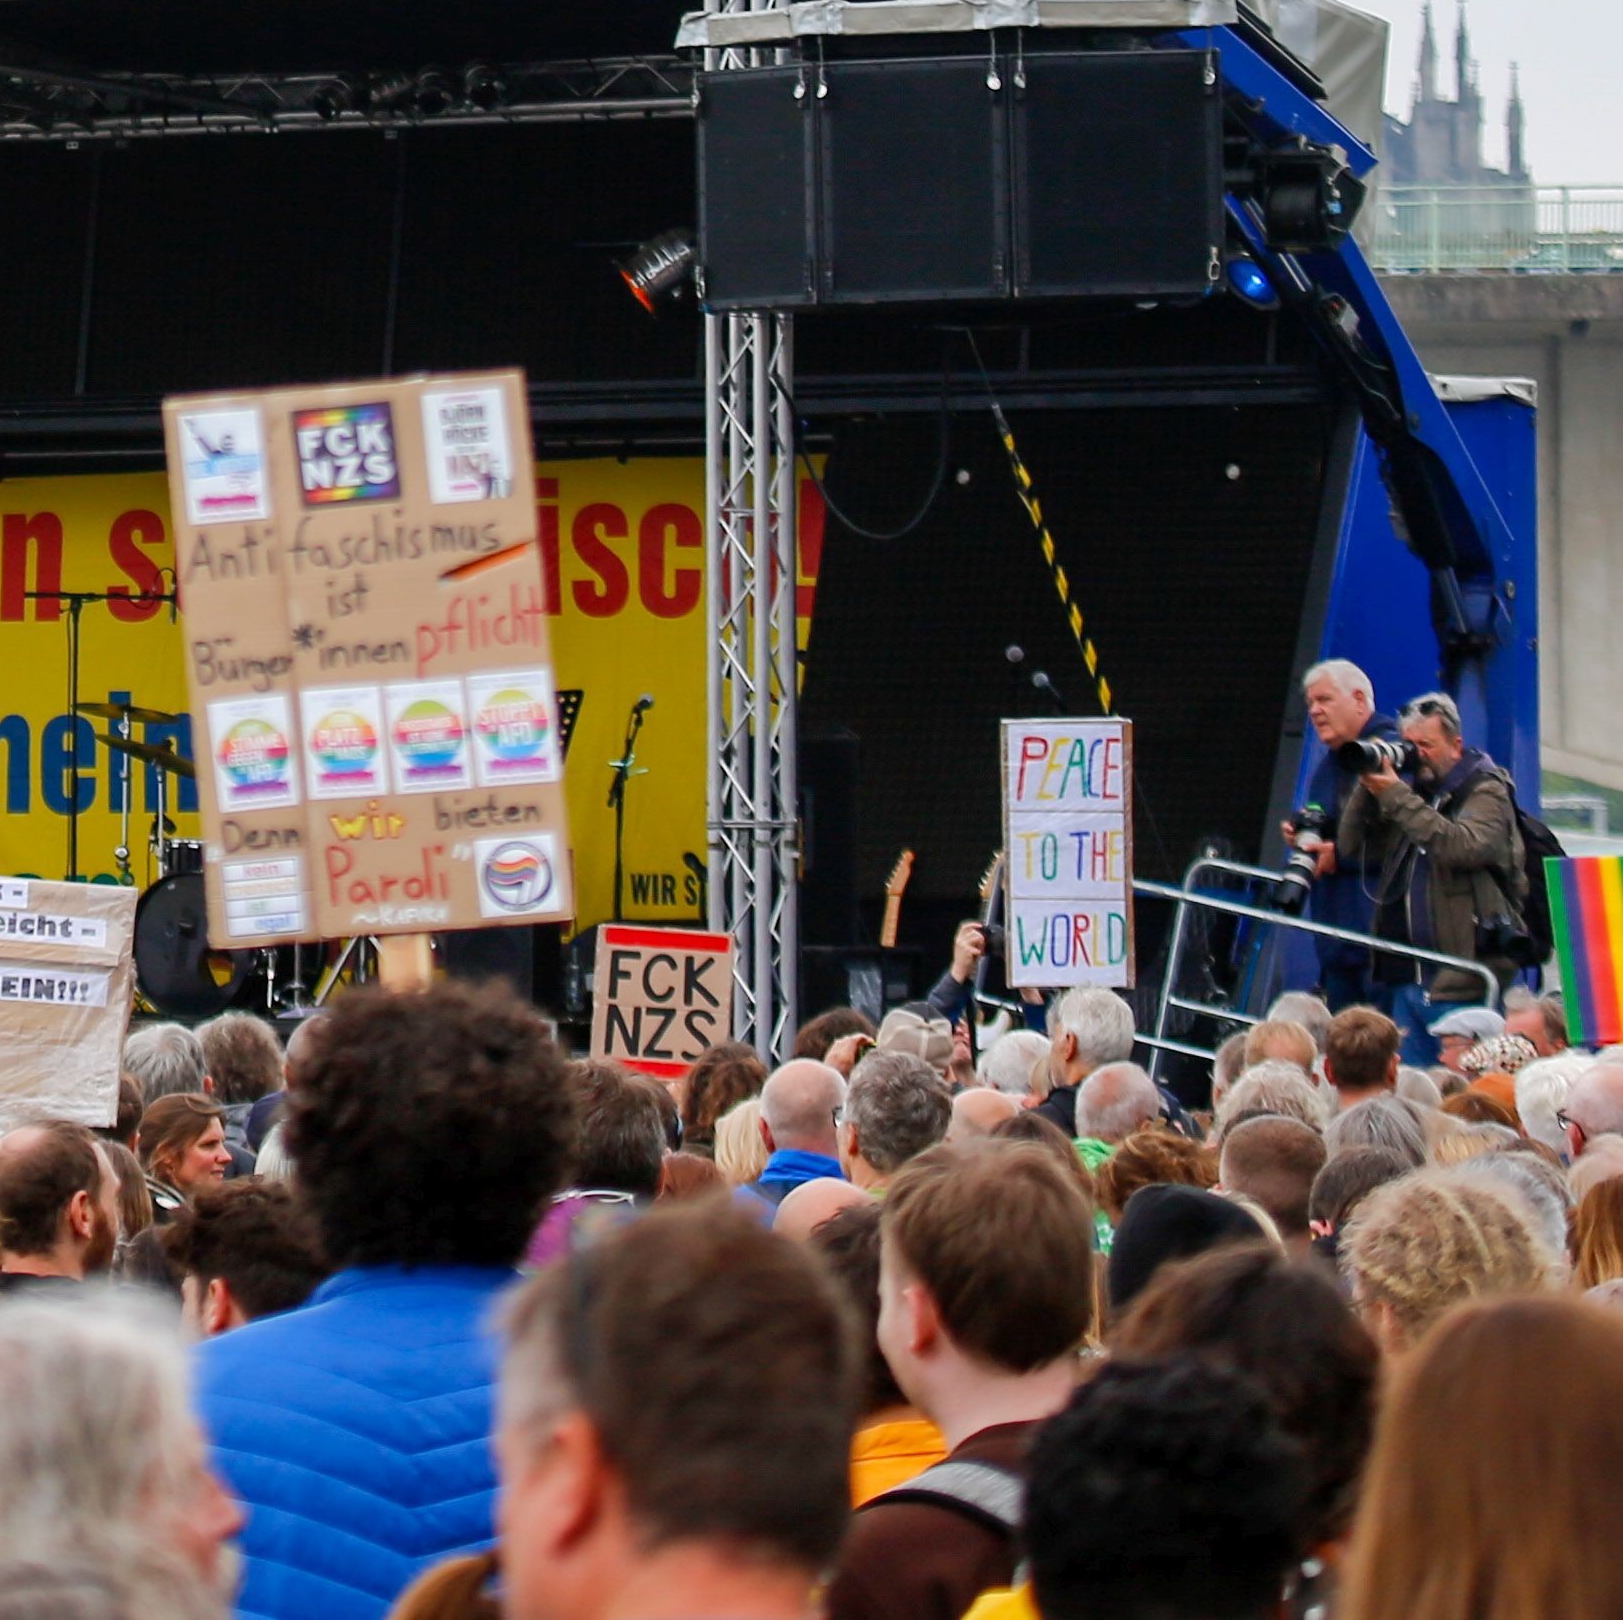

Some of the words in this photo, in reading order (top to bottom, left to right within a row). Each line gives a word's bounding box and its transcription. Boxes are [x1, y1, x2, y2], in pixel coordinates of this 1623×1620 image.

[296, 422, 390, 461] FCK
[301, 453, 396, 491] NZS
[327, 574, 369, 619] ist
[415, 583, 550, 679] pflicht
[1016, 736, 1122, 801] PEACE
[221, 819, 301, 854] Denn
[329, 799, 406, 841] wir
[432, 795, 541, 832] bieten
[1015, 832, 1058, 881] TO
[1069, 830, 1124, 882] THE
[630, 874, 677, 906] WIR
[1017, 913, 1128, 968] WORLD
[608, 949, 721, 1008] FCK
[604, 1003, 717, 1062] NZS
